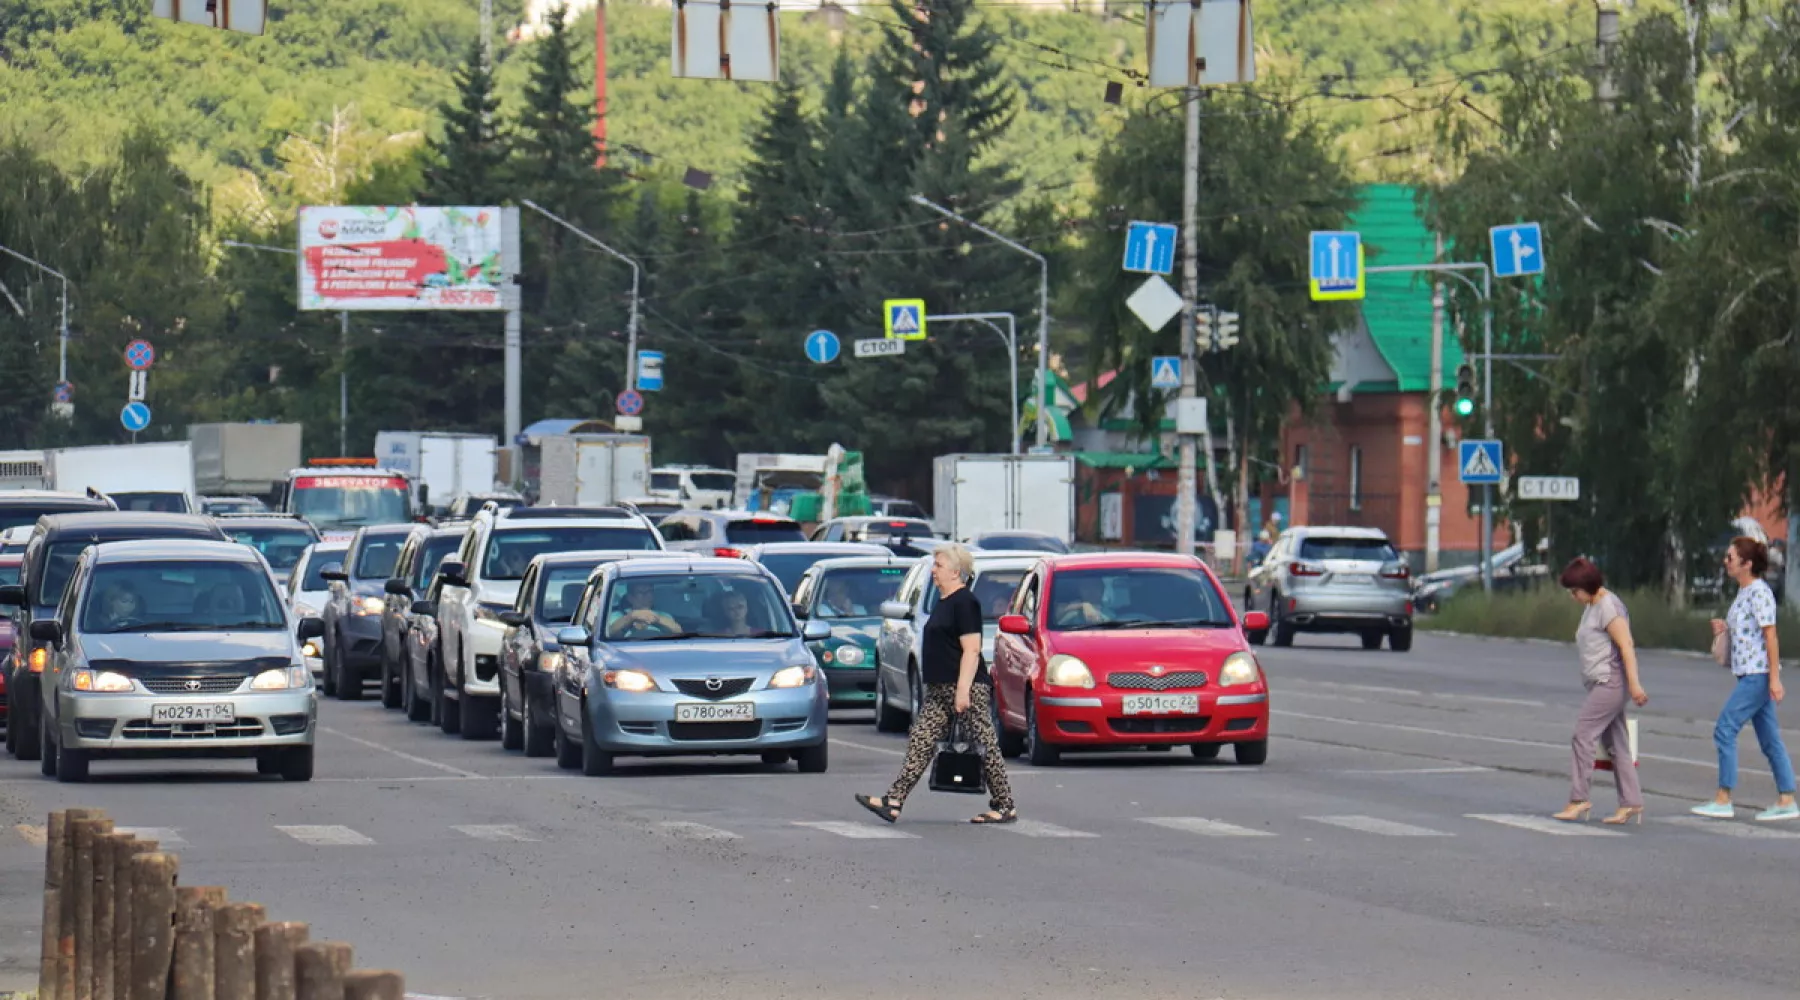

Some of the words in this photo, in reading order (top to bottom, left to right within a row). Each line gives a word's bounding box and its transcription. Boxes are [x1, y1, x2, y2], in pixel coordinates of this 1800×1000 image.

[861, 342, 898, 353] СТОП
[1523, 480, 1575, 494] СТОП
[1181, 696, 1194, 706] 22
[215, 704, 229, 715] 04
[736, 704, 749, 715] 22
